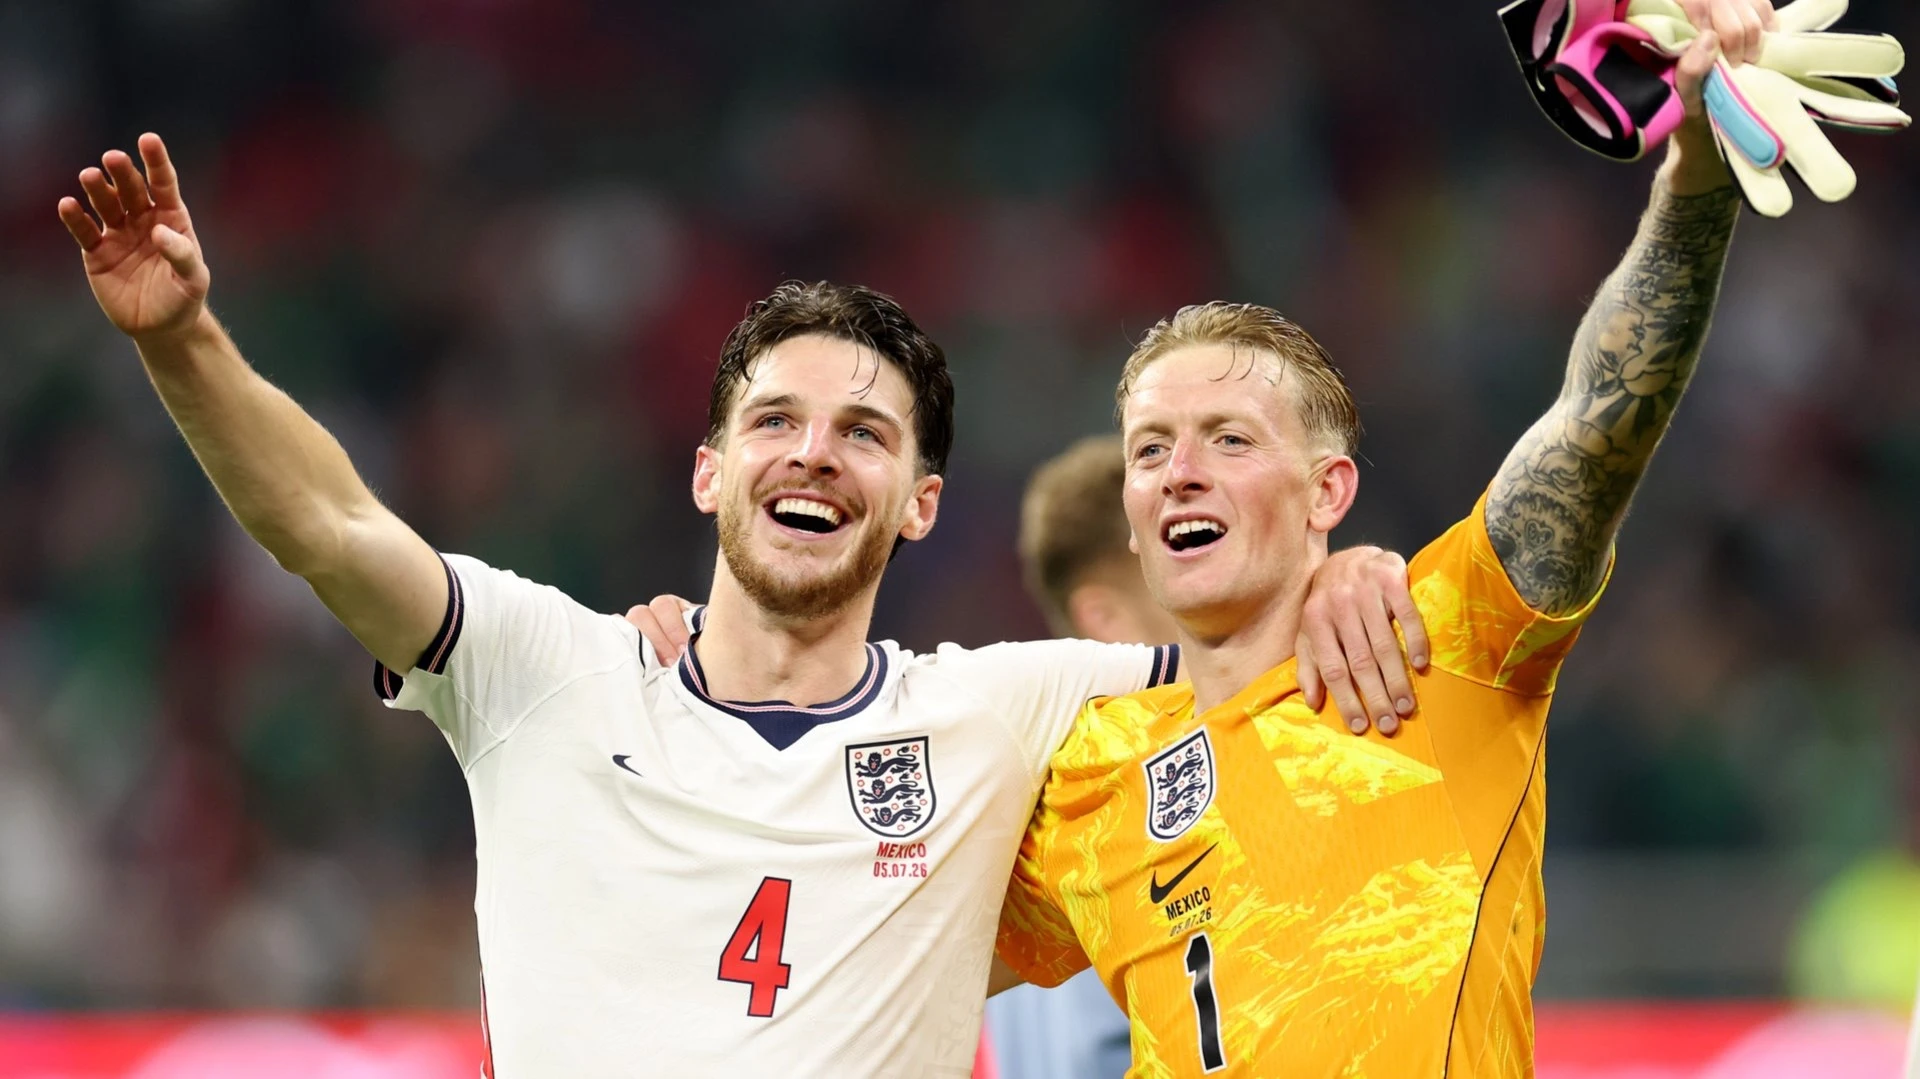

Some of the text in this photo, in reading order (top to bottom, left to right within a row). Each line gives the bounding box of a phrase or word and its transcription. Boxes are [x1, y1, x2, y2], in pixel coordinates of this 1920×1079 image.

[876, 841, 927, 859] MEXICO
[873, 861, 927, 878] 05.07.26
[1165, 886, 1211, 921] MEXICO
[1169, 907, 1212, 937] 05.07.26
[717, 876, 792, 1018] 4
[1185, 933, 1225, 1072] 1
